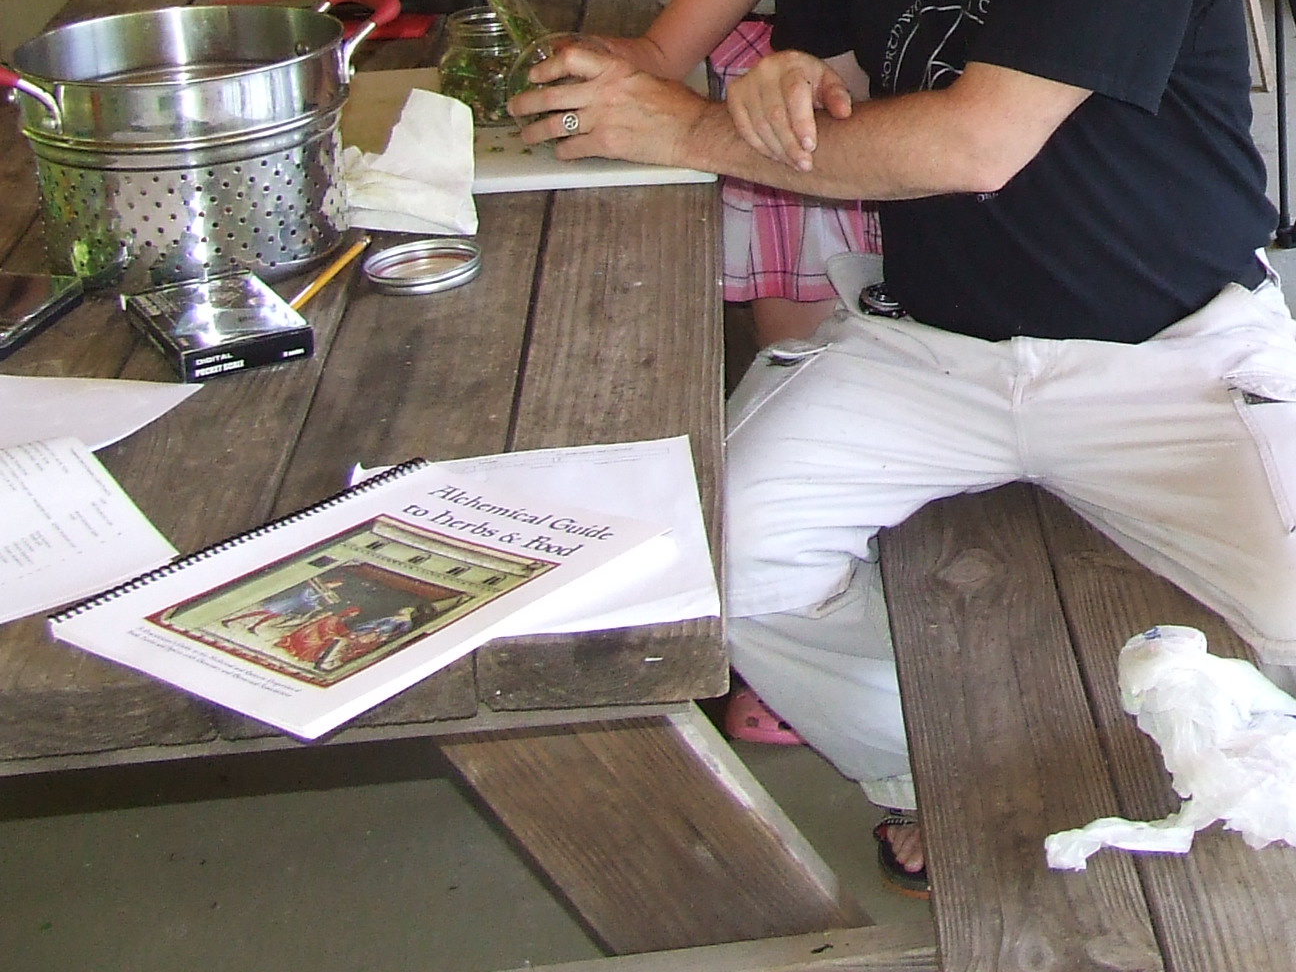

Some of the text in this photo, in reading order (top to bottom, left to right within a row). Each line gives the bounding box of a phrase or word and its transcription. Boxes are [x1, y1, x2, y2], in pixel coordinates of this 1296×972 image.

[195, 353, 233, 366] DIGITAL
[402, 503, 429, 518] to
[428, 485, 615, 541] Alchemical Guide
